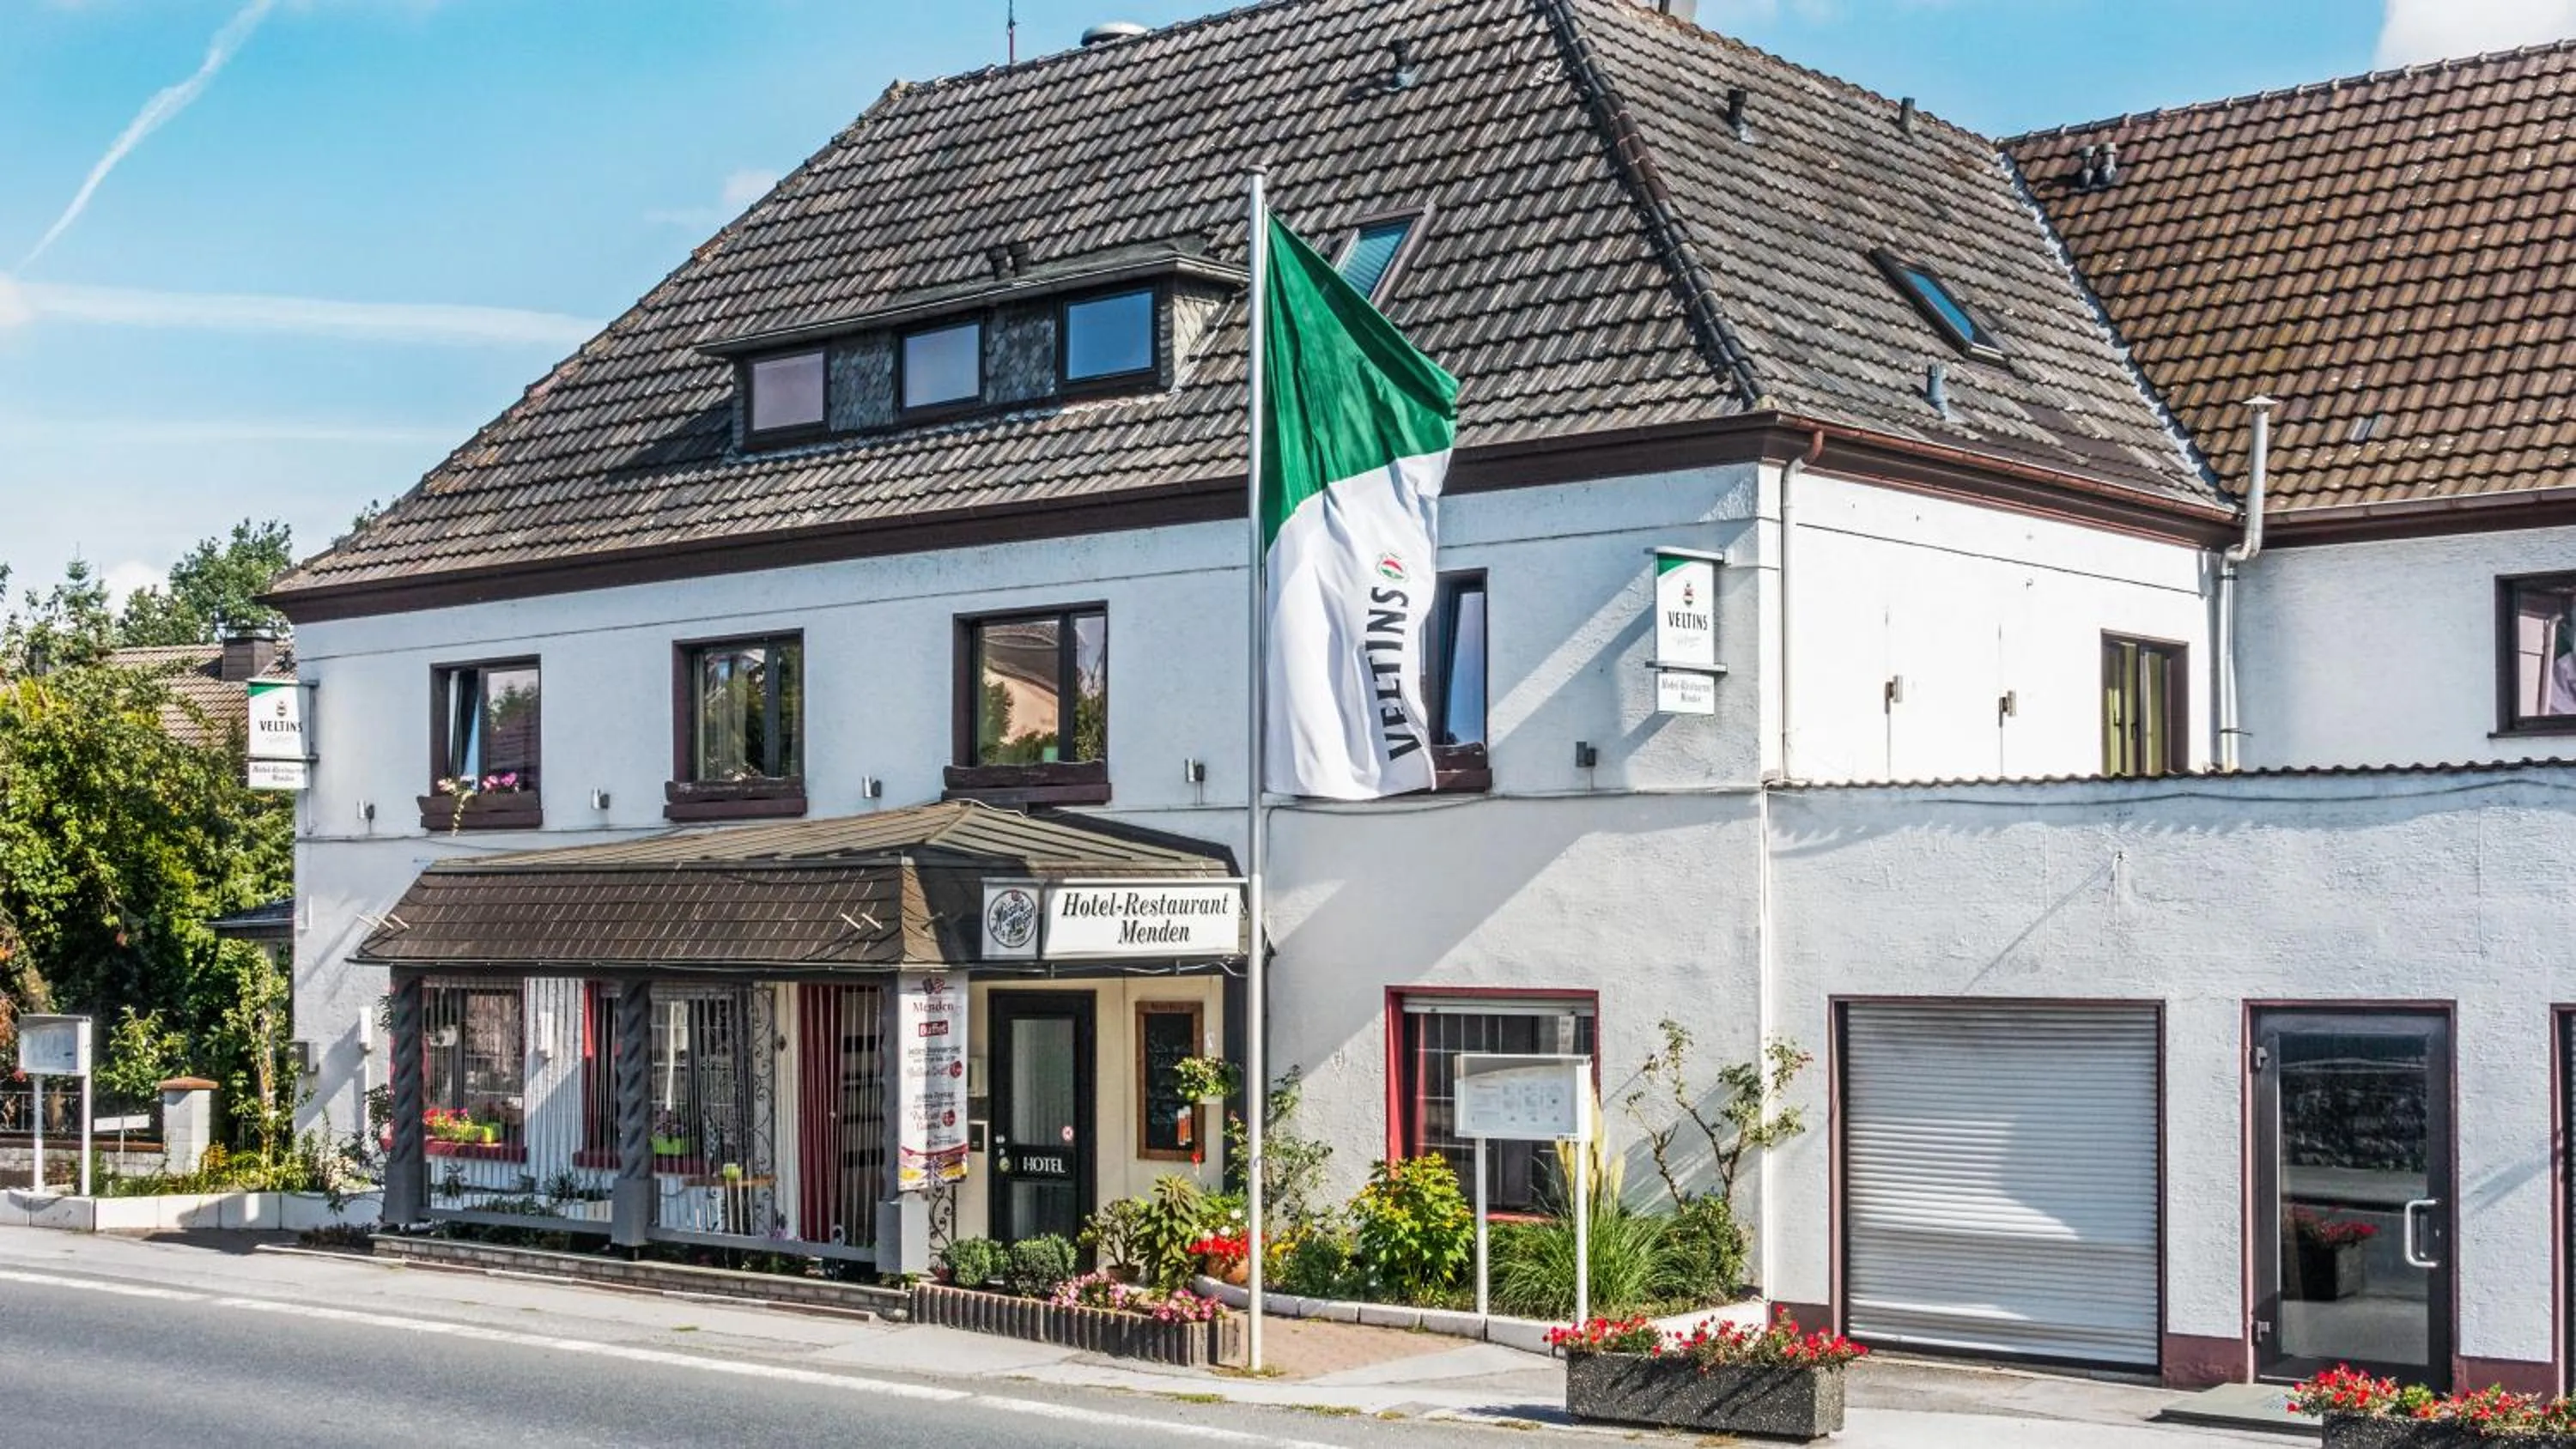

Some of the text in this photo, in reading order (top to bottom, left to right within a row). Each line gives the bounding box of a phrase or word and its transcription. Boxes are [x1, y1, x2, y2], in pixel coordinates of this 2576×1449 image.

[1668, 610, 1708, 631] VELTINS
[1365, 586, 1422, 761] VELTINS
[259, 720, 303, 732] VELTINS
[1061, 891, 1229, 918] Hotel-Restaurant
[1117, 919, 1190, 945] Menden
[913, 1000, 955, 1013] Menden
[1023, 1156, 1065, 1173] HOTEL
